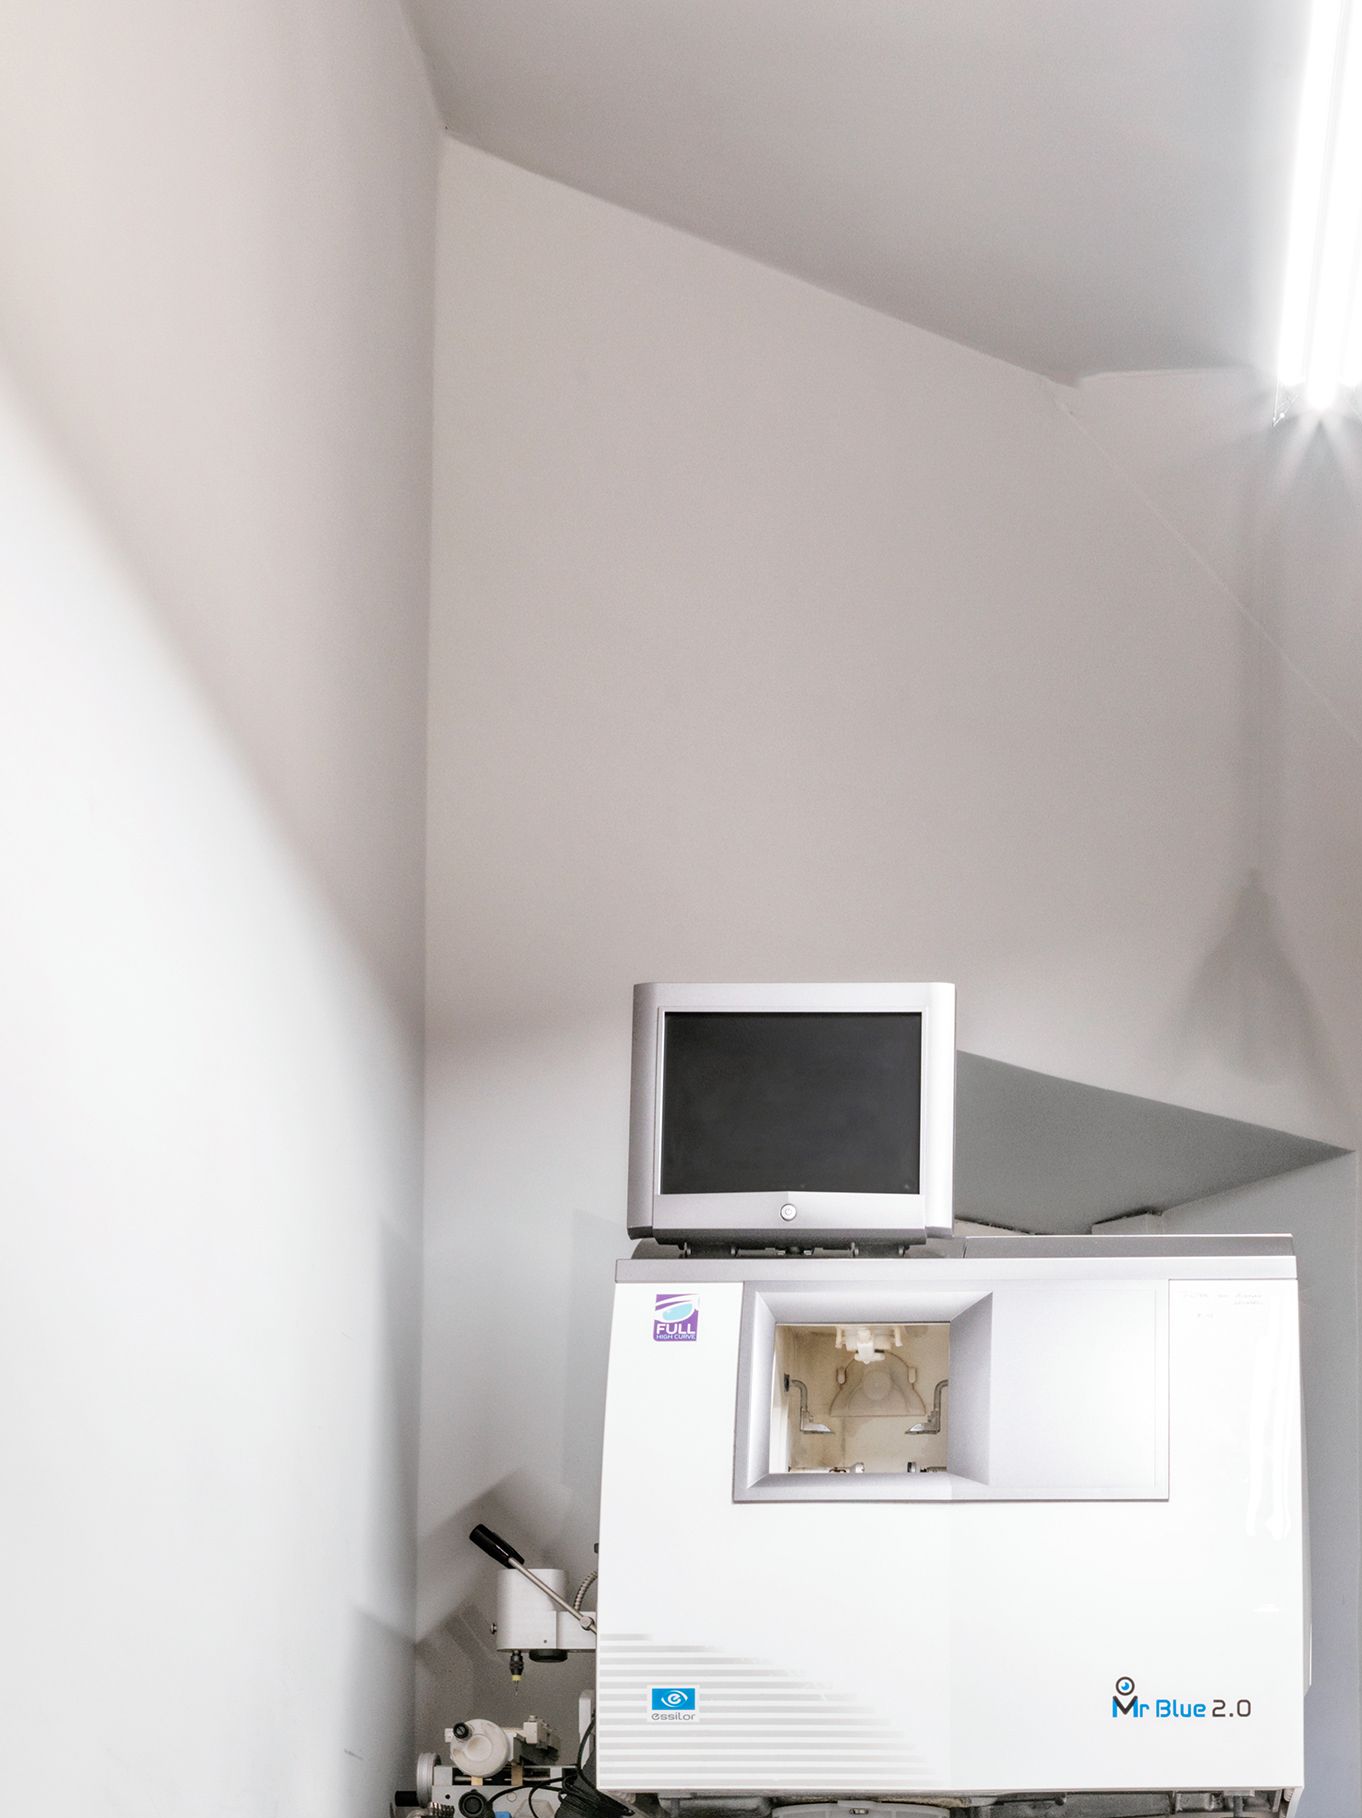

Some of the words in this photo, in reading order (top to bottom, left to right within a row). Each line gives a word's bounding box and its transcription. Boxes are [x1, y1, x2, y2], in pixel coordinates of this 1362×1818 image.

[656, 1323, 696, 1335] FULL
[1112, 1695, 1150, 1718] Mr
[1156, 1699, 1206, 1718] Blue
[1212, 1699, 1252, 1718] 2.0
[651, 1712, 696, 1721] essilor
